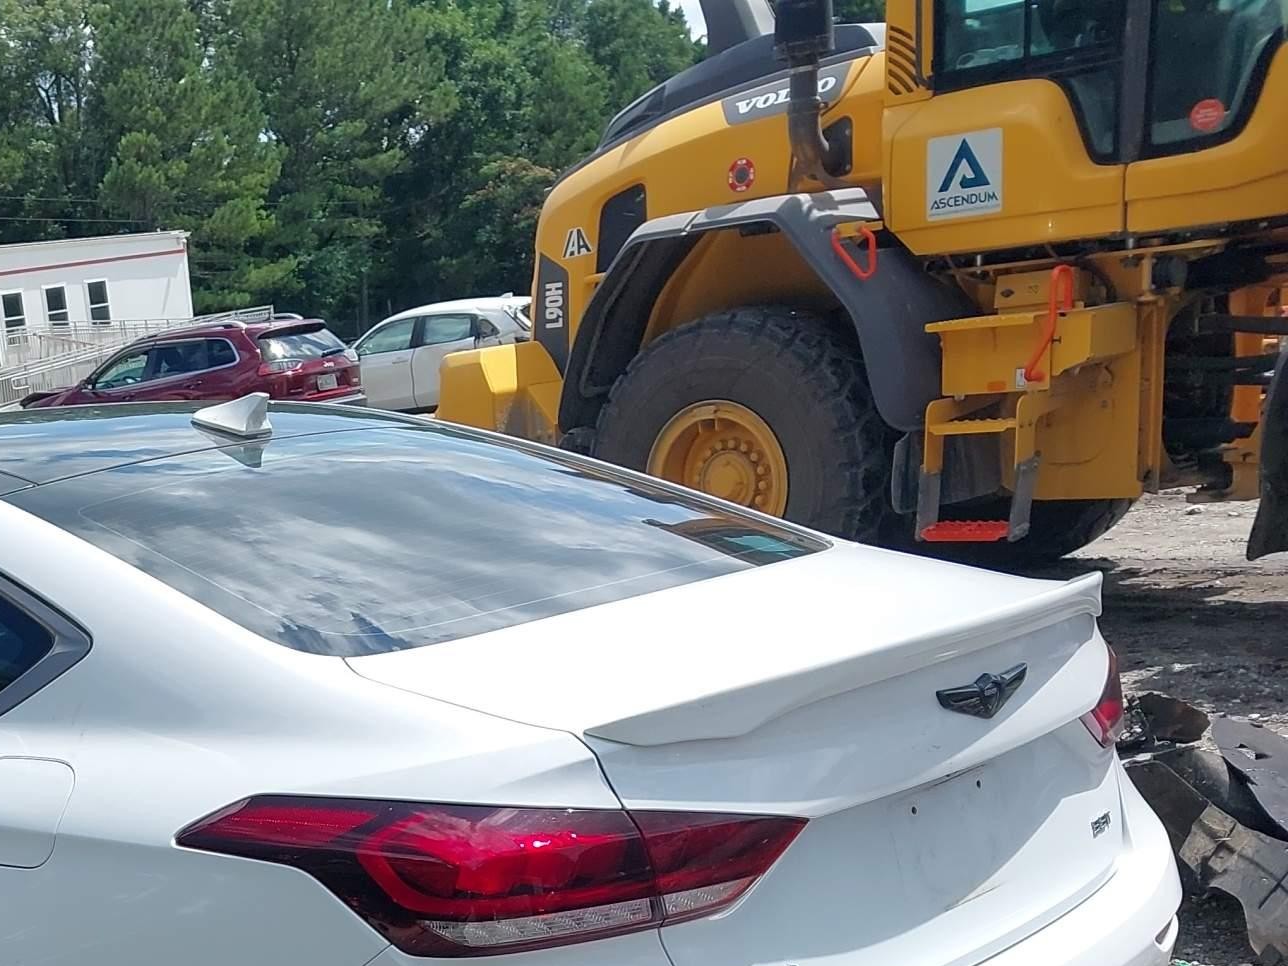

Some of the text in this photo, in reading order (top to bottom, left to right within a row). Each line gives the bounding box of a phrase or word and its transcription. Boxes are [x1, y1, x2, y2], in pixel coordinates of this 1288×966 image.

[735, 76, 836, 115] VOLO
[930, 191, 999, 211] ASCENDUM
[544, 281, 564, 329] L90H
